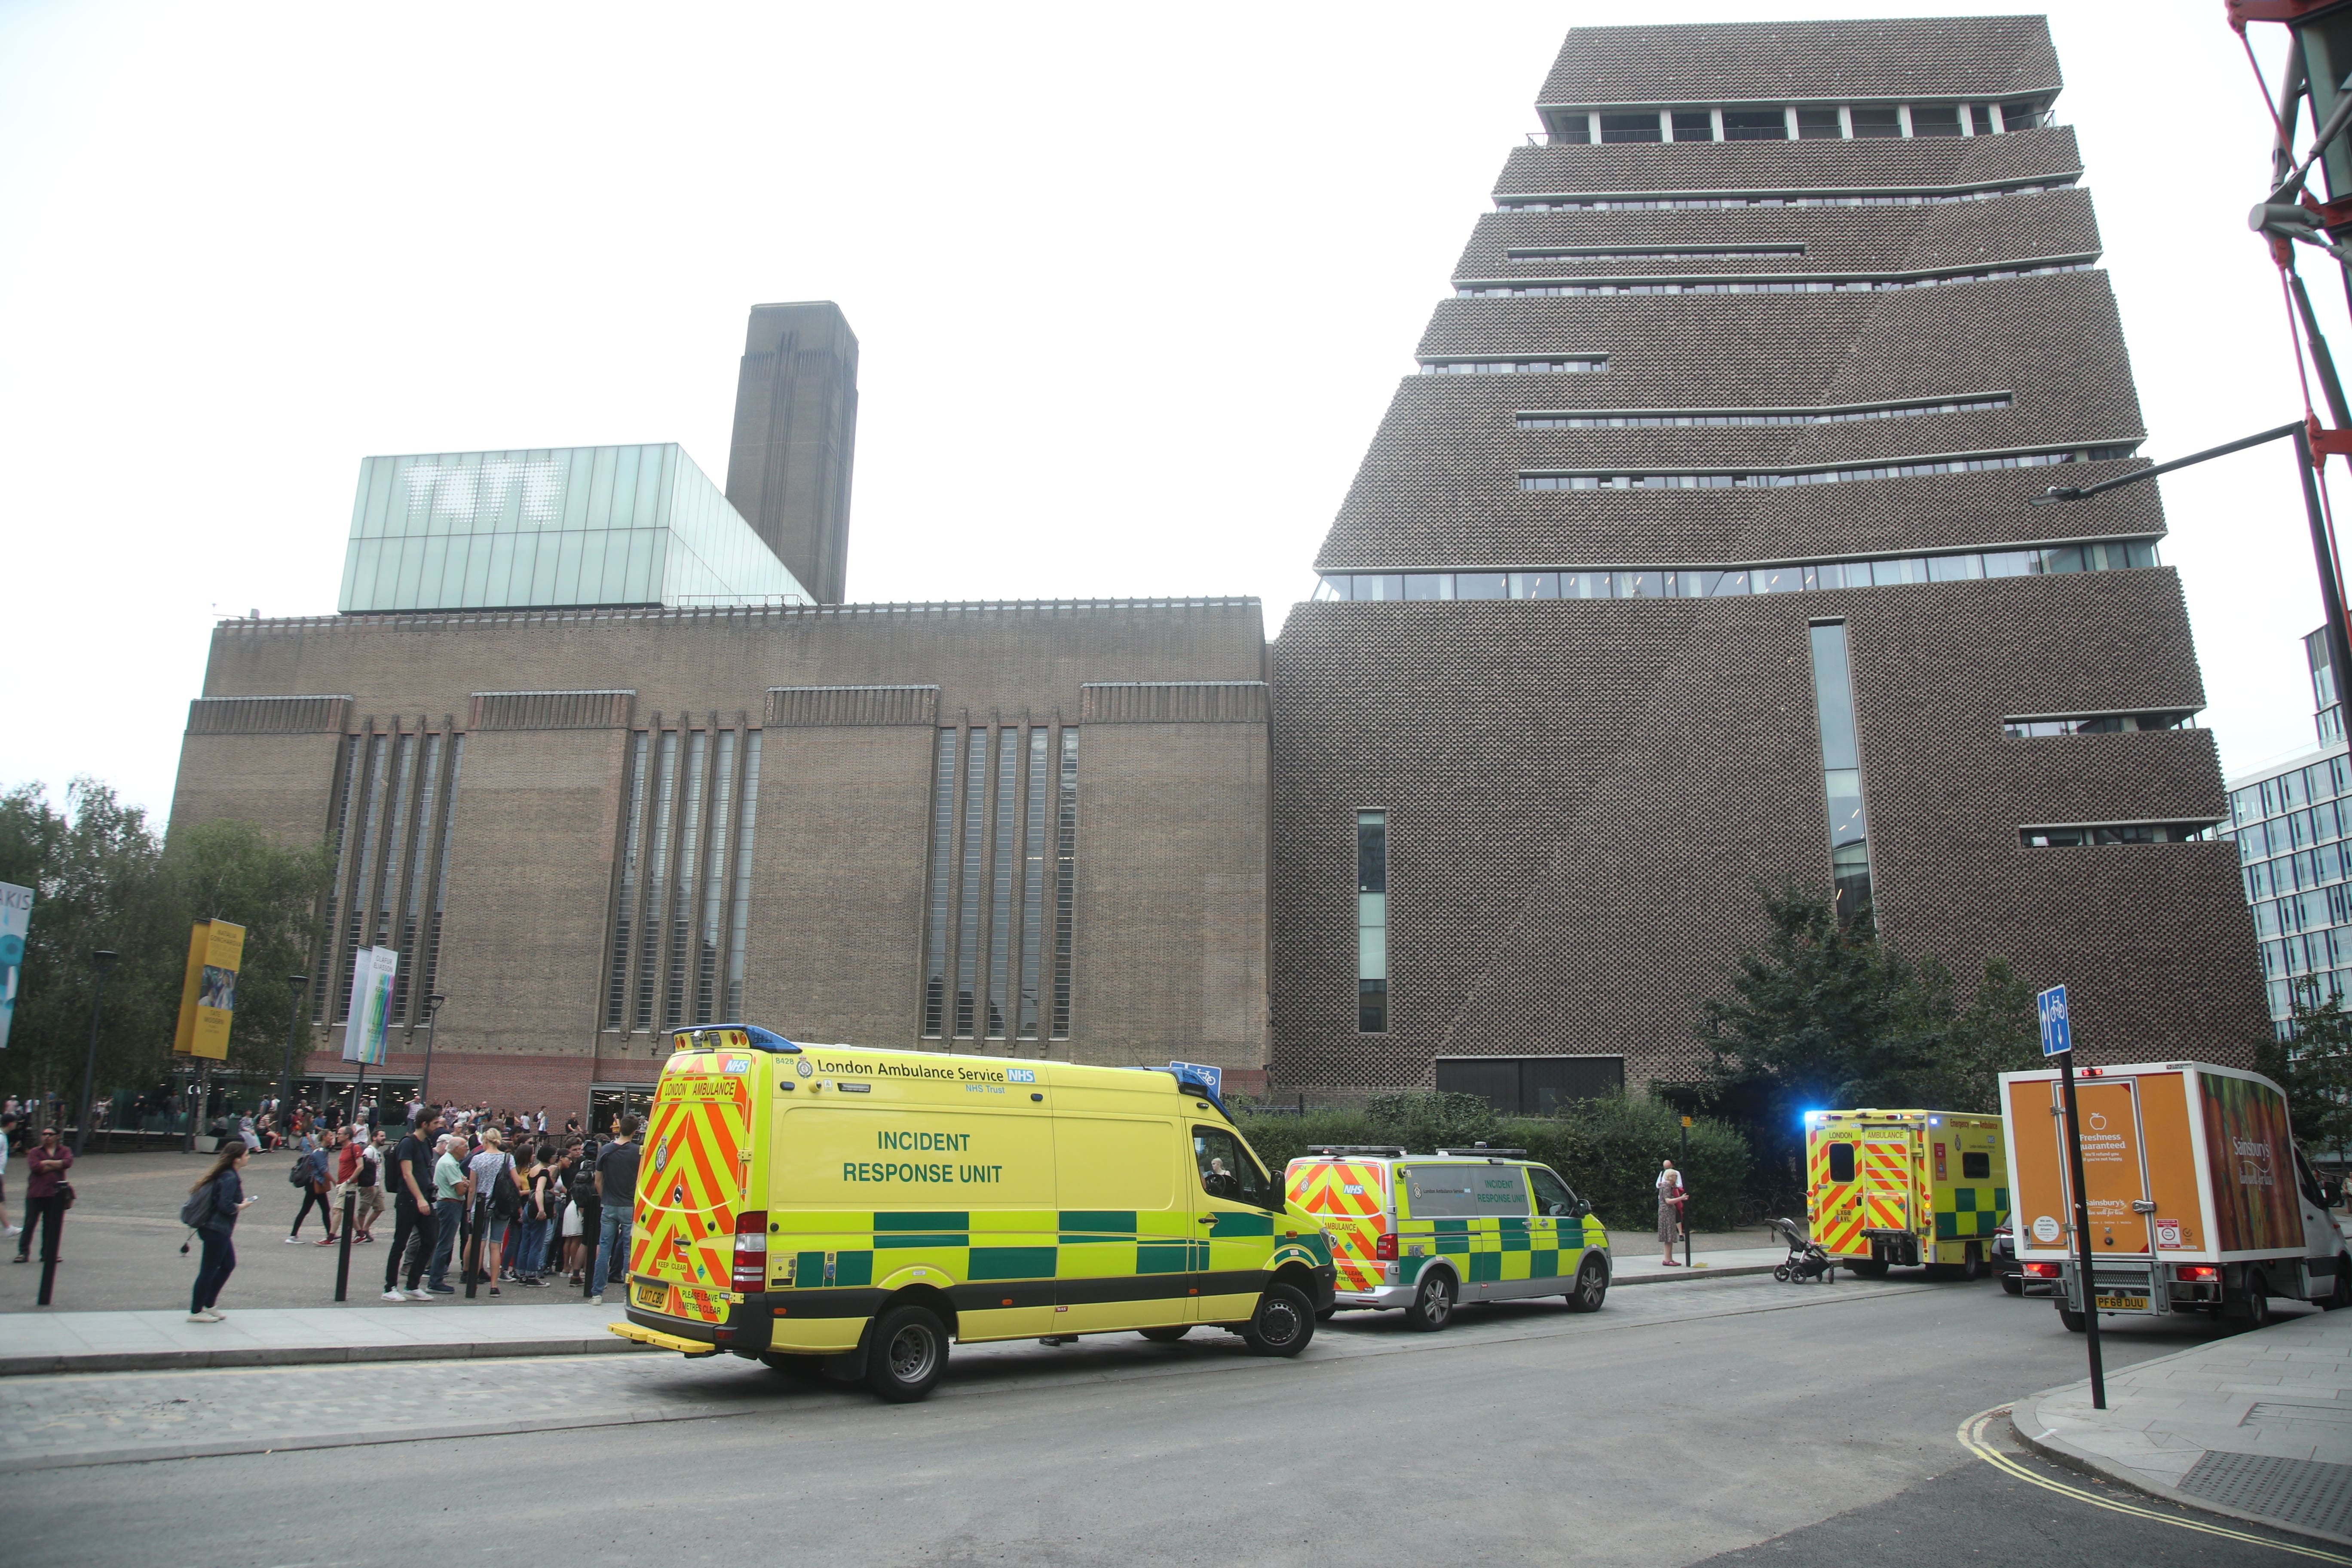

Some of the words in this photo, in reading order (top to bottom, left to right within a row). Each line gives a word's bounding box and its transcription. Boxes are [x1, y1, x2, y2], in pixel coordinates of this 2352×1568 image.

[376, 955, 392, 965] OLAFUR
[373, 962, 393, 972] ELIASSON
[725, 1060, 748, 1072] NHS
[818, 1059, 873, 1074] London
[878, 1063, 954, 1079] Ambulance
[958, 1067, 1004, 1081] Service
[1008, 1069, 1034, 1082] NHS
[665, 1083, 687, 1096] LONDON
[692, 1082, 735, 1096] AMBULANCE
[966, 1084, 984, 1092] NHS
[986, 1085, 1005, 1093] Trust
[1951, 1119, 1969, 1129] Emergency
[1980, 1121, 1997, 1130] Ambulance
[878, 1131, 970, 1151] INCIDENT
[2233, 1136, 2269, 1161] Sainsbury's
[844, 1163, 953, 1182] RESPONSE
[960, 1165, 1002, 1183] UNIT
[1485, 1180, 1513, 1188] INCIDENT
[1344, 1185, 1363, 1194] NHS
[1477, 1194, 1511, 1202] RESPONSE
[1512, 1194, 1525, 1203] UNIT
[1324, 1222, 1356, 1231] AMBULANCE
[672, 1262, 686, 1271] CLEAR
[682, 1290, 700, 1301] PLEASE
[701, 1292, 718, 1302] LEAVE
[2098, 1298, 2122, 1307] PF68
[2125, 1298, 2143, 1307] DUU
[683, 1302, 701, 1312] METRES
[703, 1305, 721, 1314] CLEAR
